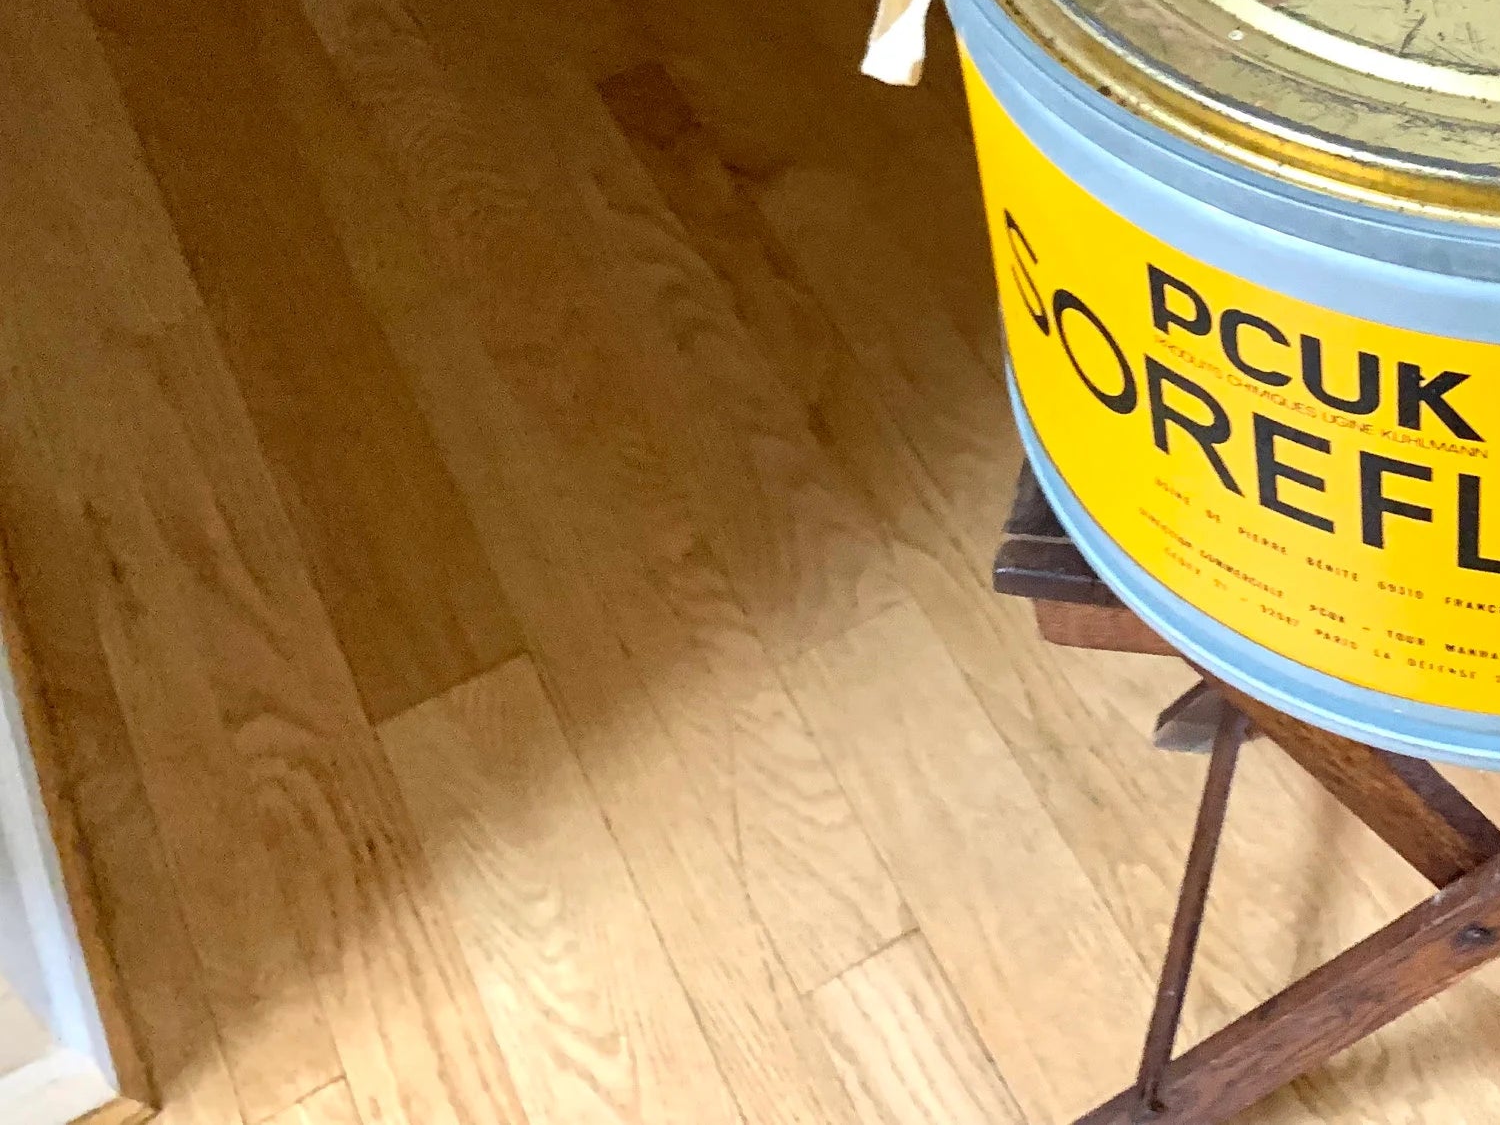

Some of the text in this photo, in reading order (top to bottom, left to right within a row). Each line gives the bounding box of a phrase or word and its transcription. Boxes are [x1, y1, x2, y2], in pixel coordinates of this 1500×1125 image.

[1147, 262, 1486, 443] PCUK
[1321, 411, 1375, 437] UGINE
[1379, 427, 1490, 459] KUHLMANN
[1387, 630, 1425, 646] TOUR
